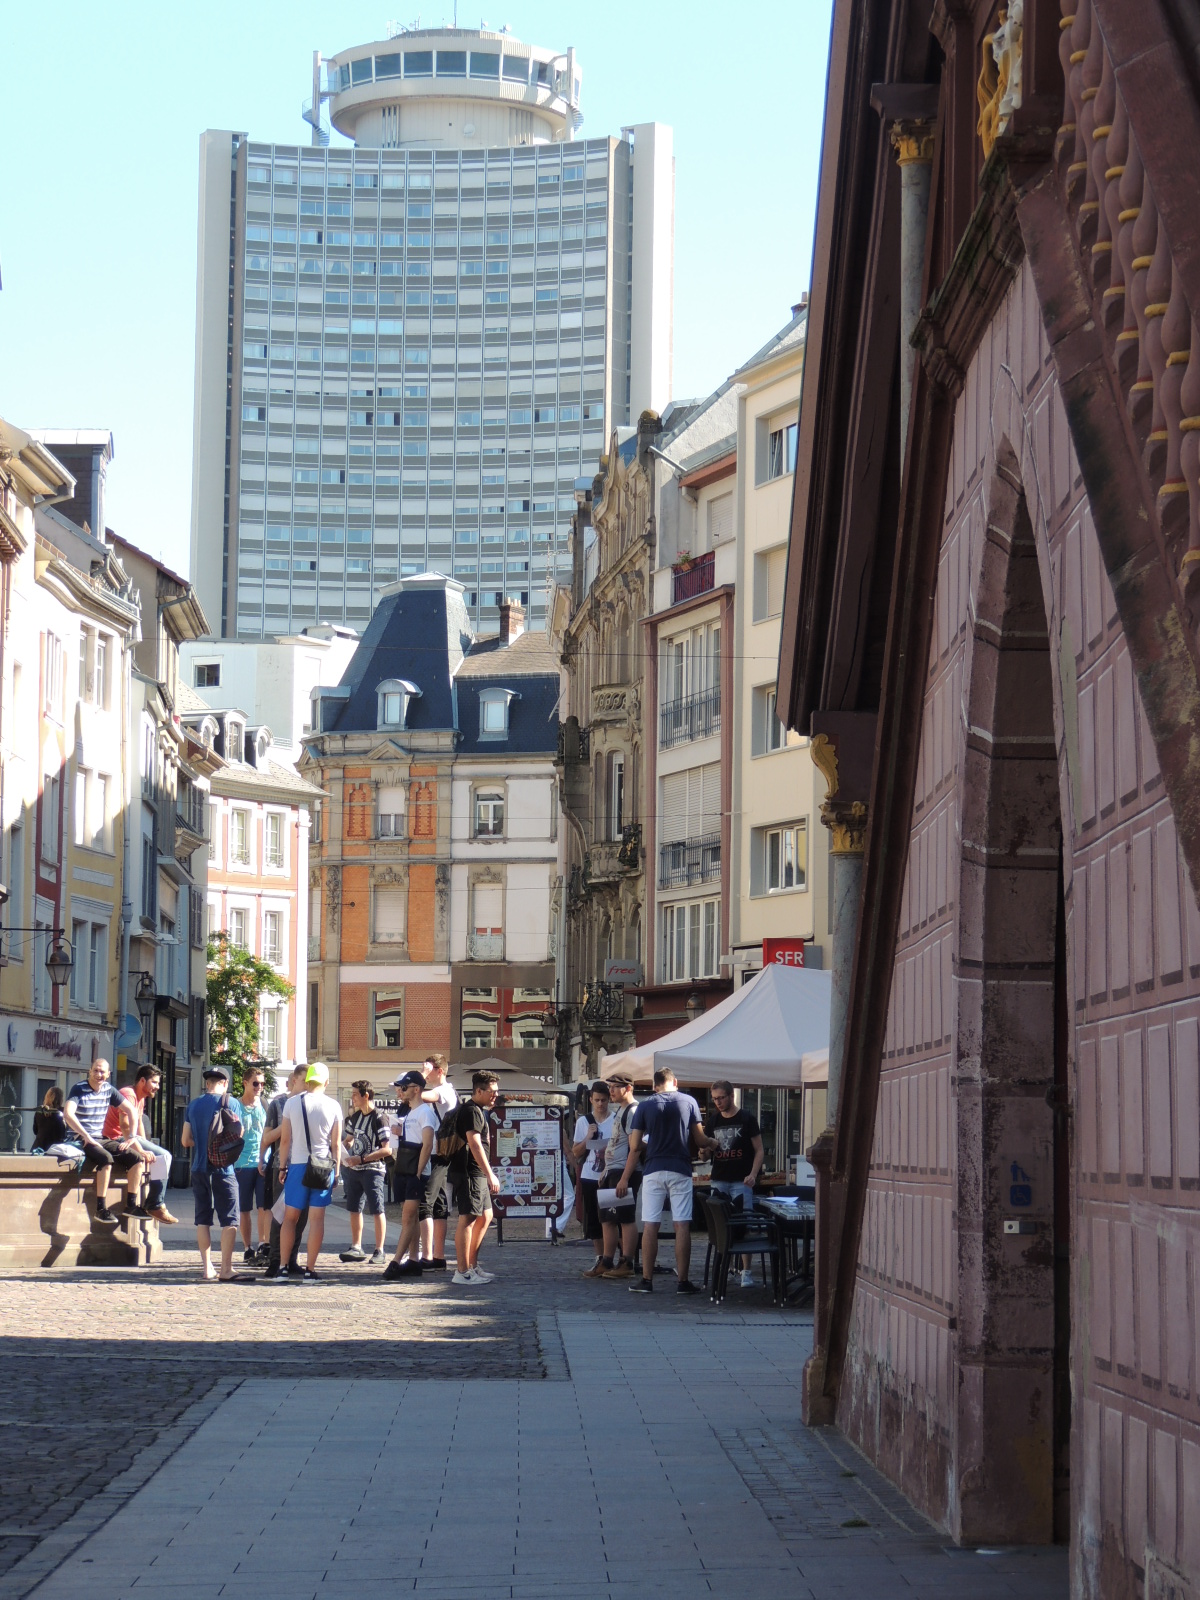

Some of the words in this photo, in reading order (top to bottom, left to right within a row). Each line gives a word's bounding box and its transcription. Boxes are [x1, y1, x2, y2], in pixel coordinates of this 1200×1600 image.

[775, 950, 804, 965] SFR
[608, 965, 636, 976] free
[721, 1138, 731, 1151] &
[715, 1149, 743, 1159] ONES
[513, 1167, 531, 1175] GLACES
